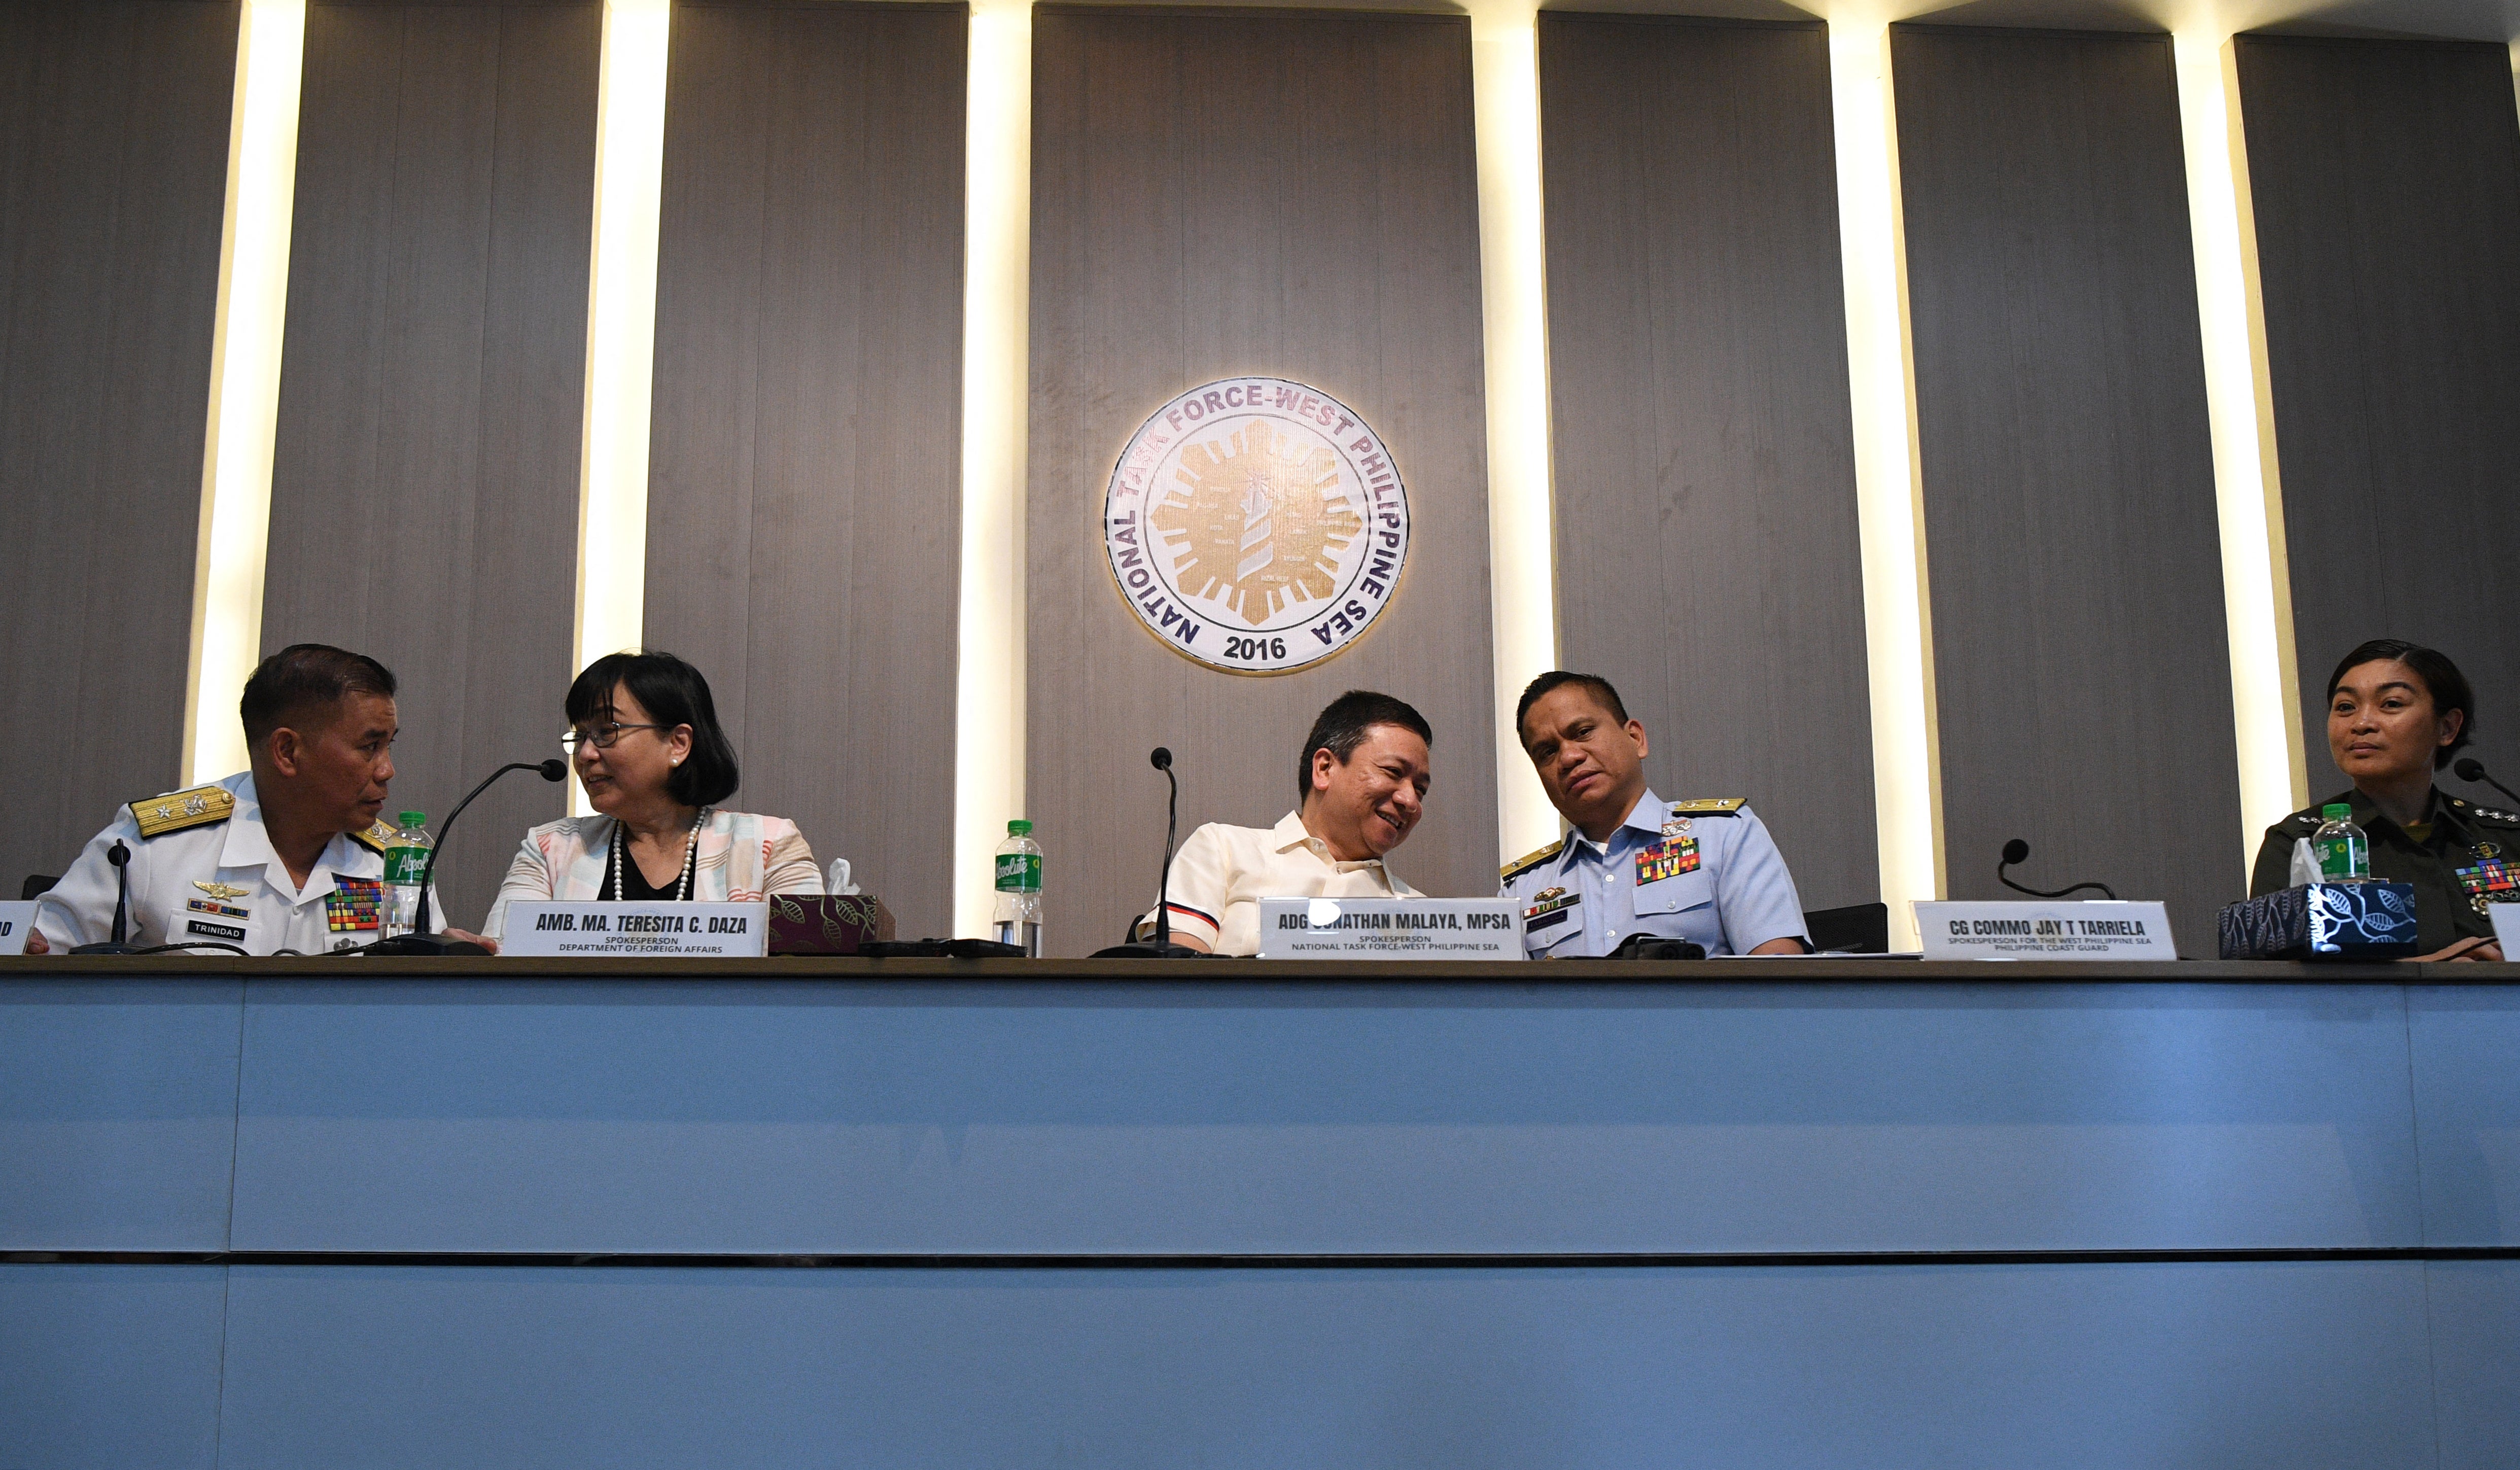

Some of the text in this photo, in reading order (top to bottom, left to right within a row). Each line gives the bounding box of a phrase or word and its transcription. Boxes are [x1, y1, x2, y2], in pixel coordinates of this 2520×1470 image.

[1116, 426, 1170, 497] TASK
[1350, 436, 1401, 600] PHILIPPINE
[1114, 510, 1201, 645] NATIONAL
[1311, 600, 1367, 646] SEA
[1224, 637, 1286, 660] 2016
[195, 924, 240, 937] TRINIDAD
[536, 914, 747, 934] AMB. MA. TERESITA C. DAZA
[1279, 914, 1308, 929] ADG
[1396, 914, 1462, 931] MALAYA,
[1467, 914, 1511, 929] MPSA
[1949, 920, 2146, 935] CG COMMO JAY T TARRIELA
